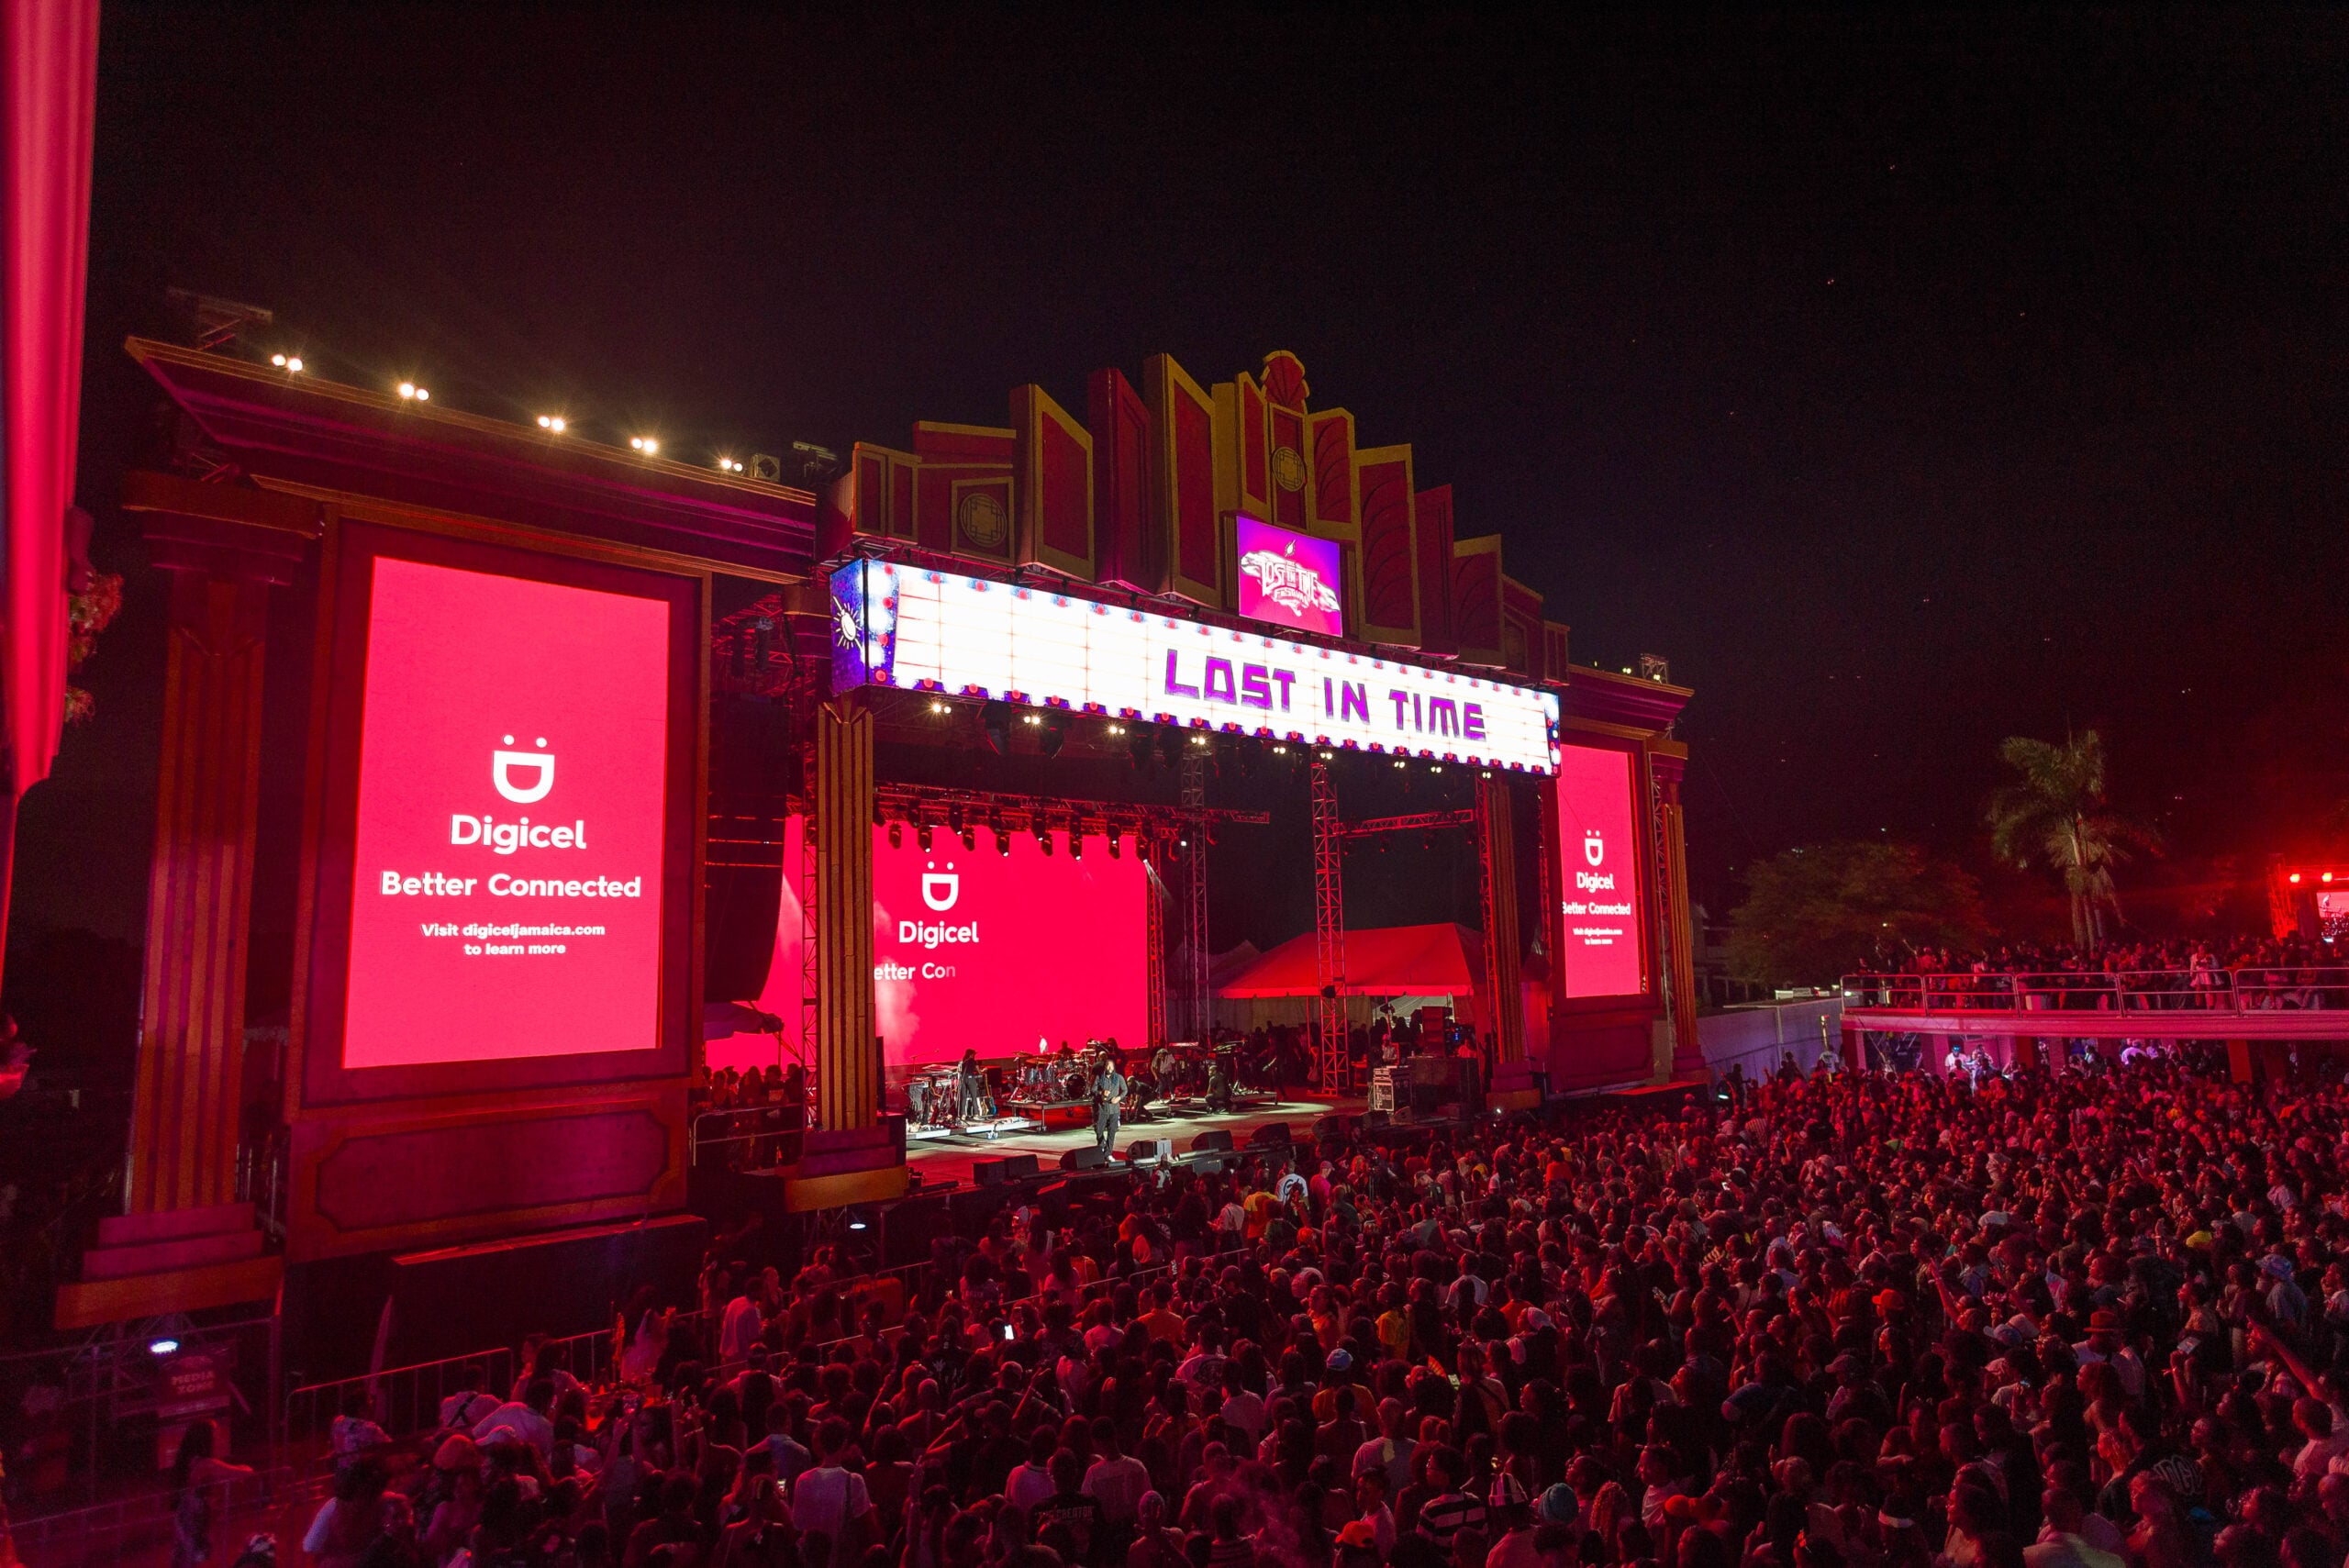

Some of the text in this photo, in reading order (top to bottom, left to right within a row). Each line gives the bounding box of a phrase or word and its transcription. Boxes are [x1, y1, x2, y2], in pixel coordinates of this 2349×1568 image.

[1163, 648, 1487, 742] LOST IN TIME
[451, 813, 587, 855] Digicel
[381, 871, 641, 898] Better Connected
[1576, 872, 1615, 894] Digicel
[1588, 901, 1631, 916] Connected
[421, 922, 606, 940] Visit digiceljamaica.com
[899, 920, 980, 950] Digicel
[463, 942, 566, 956] to learn more
[874, 962, 916, 980] etter
